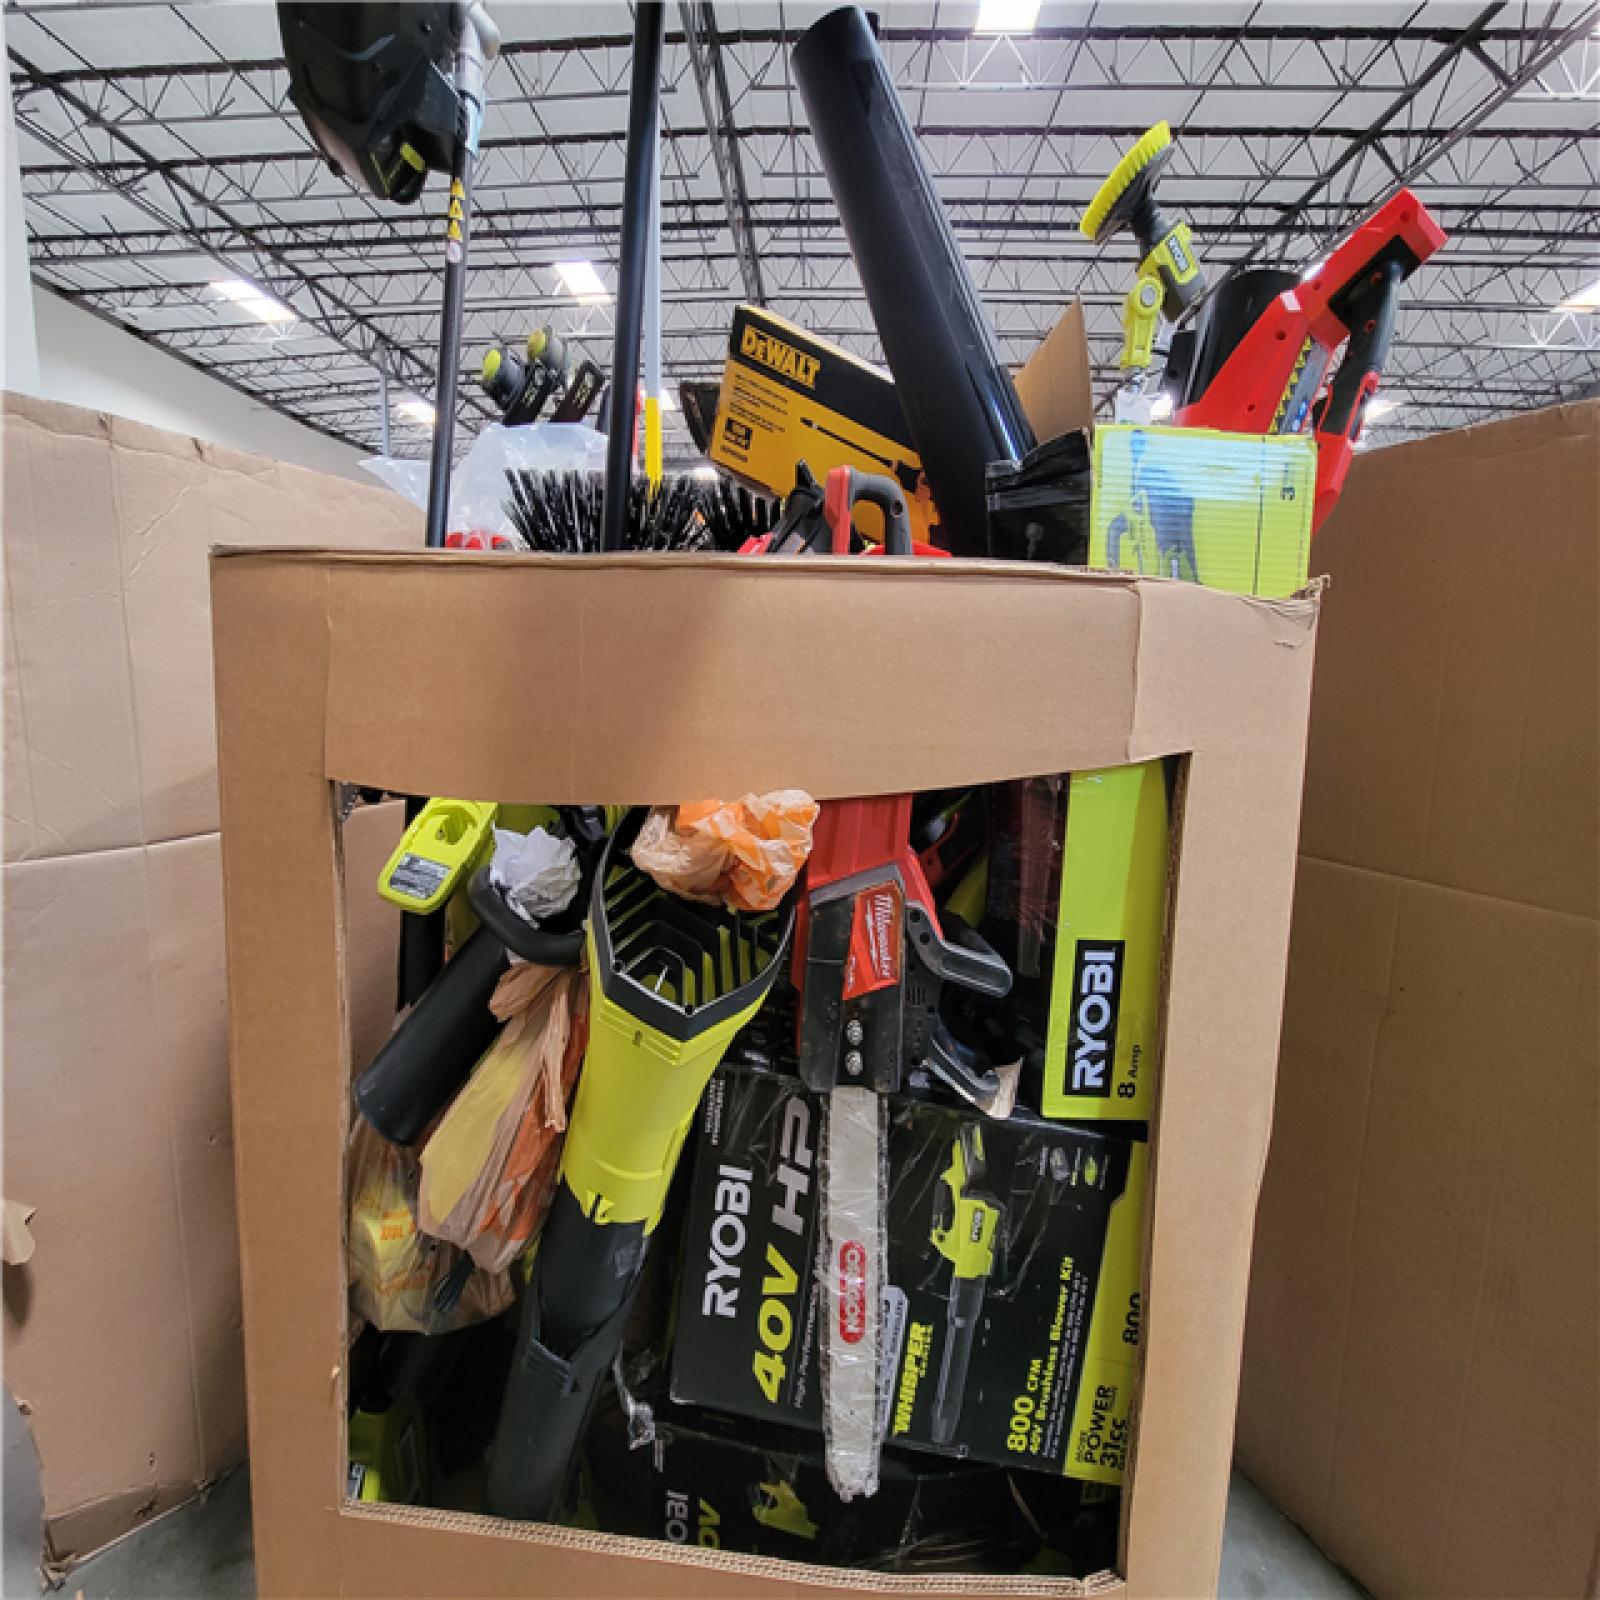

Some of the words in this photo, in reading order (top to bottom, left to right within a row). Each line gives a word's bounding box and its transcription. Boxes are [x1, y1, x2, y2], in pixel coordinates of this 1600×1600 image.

[1072, 950, 1116, 1089] RYOBI
[1117, 1080, 1137, 1099] 8
[1128, 1044, 1142, 1079] Amp
[772, 1096, 813, 1236] HP
[702, 1164, 754, 1319] RYOBI
[752, 1242, 799, 1404] 40V
[892, 1321, 921, 1437] WHISPER
[1006, 1394, 1035, 1453] 800
[1083, 1384, 1113, 1465] POWER
[664, 1489, 689, 1543] OBI
[697, 1497, 722, 1550] 0V
